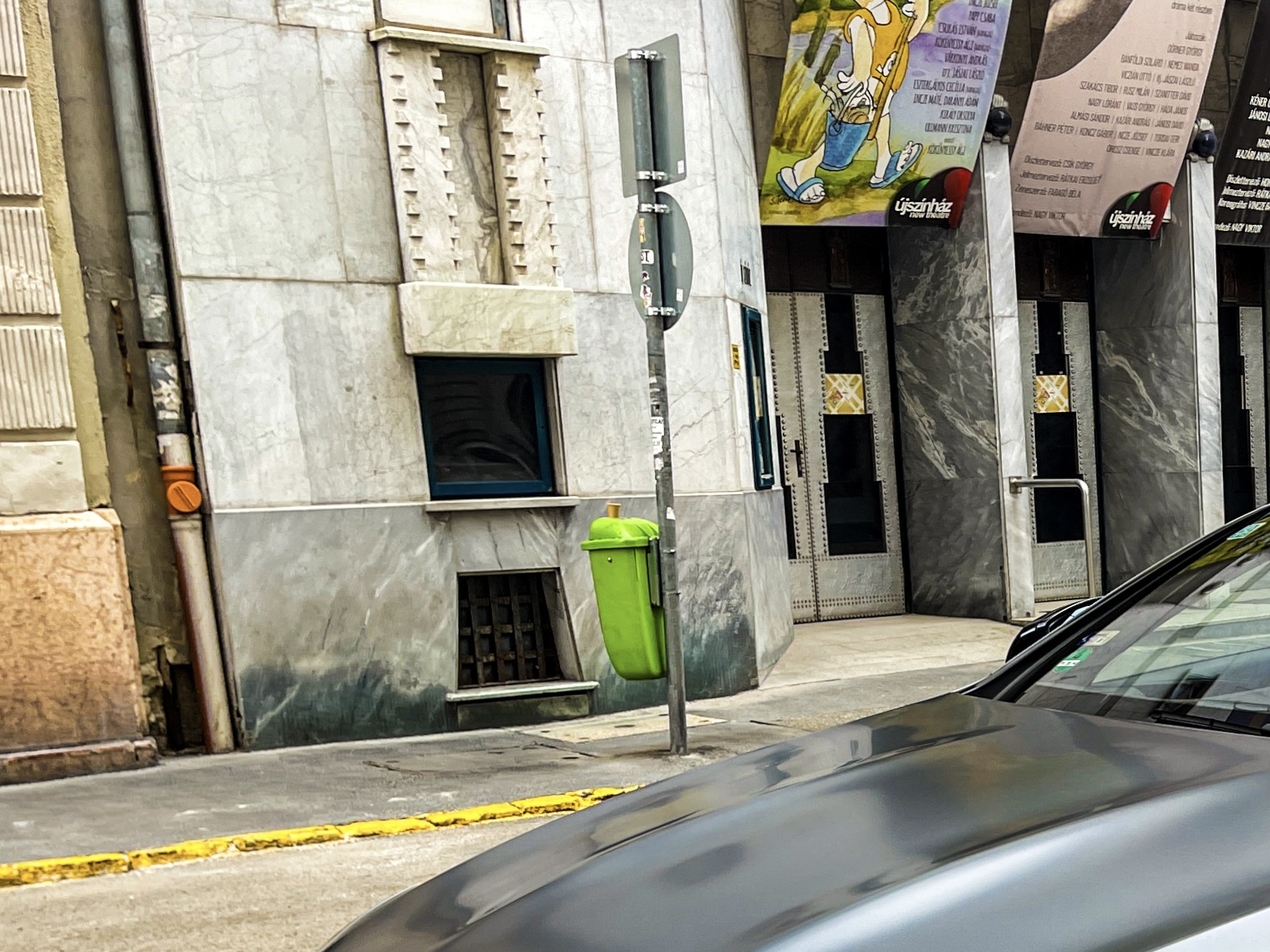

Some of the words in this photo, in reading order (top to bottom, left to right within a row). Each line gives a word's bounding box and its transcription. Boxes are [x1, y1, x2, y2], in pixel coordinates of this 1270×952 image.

[1104, 84, 1118, 93] TIBOR
[894, 197, 953, 215] újszínház
[1109, 210, 1156, 227] újszínház
